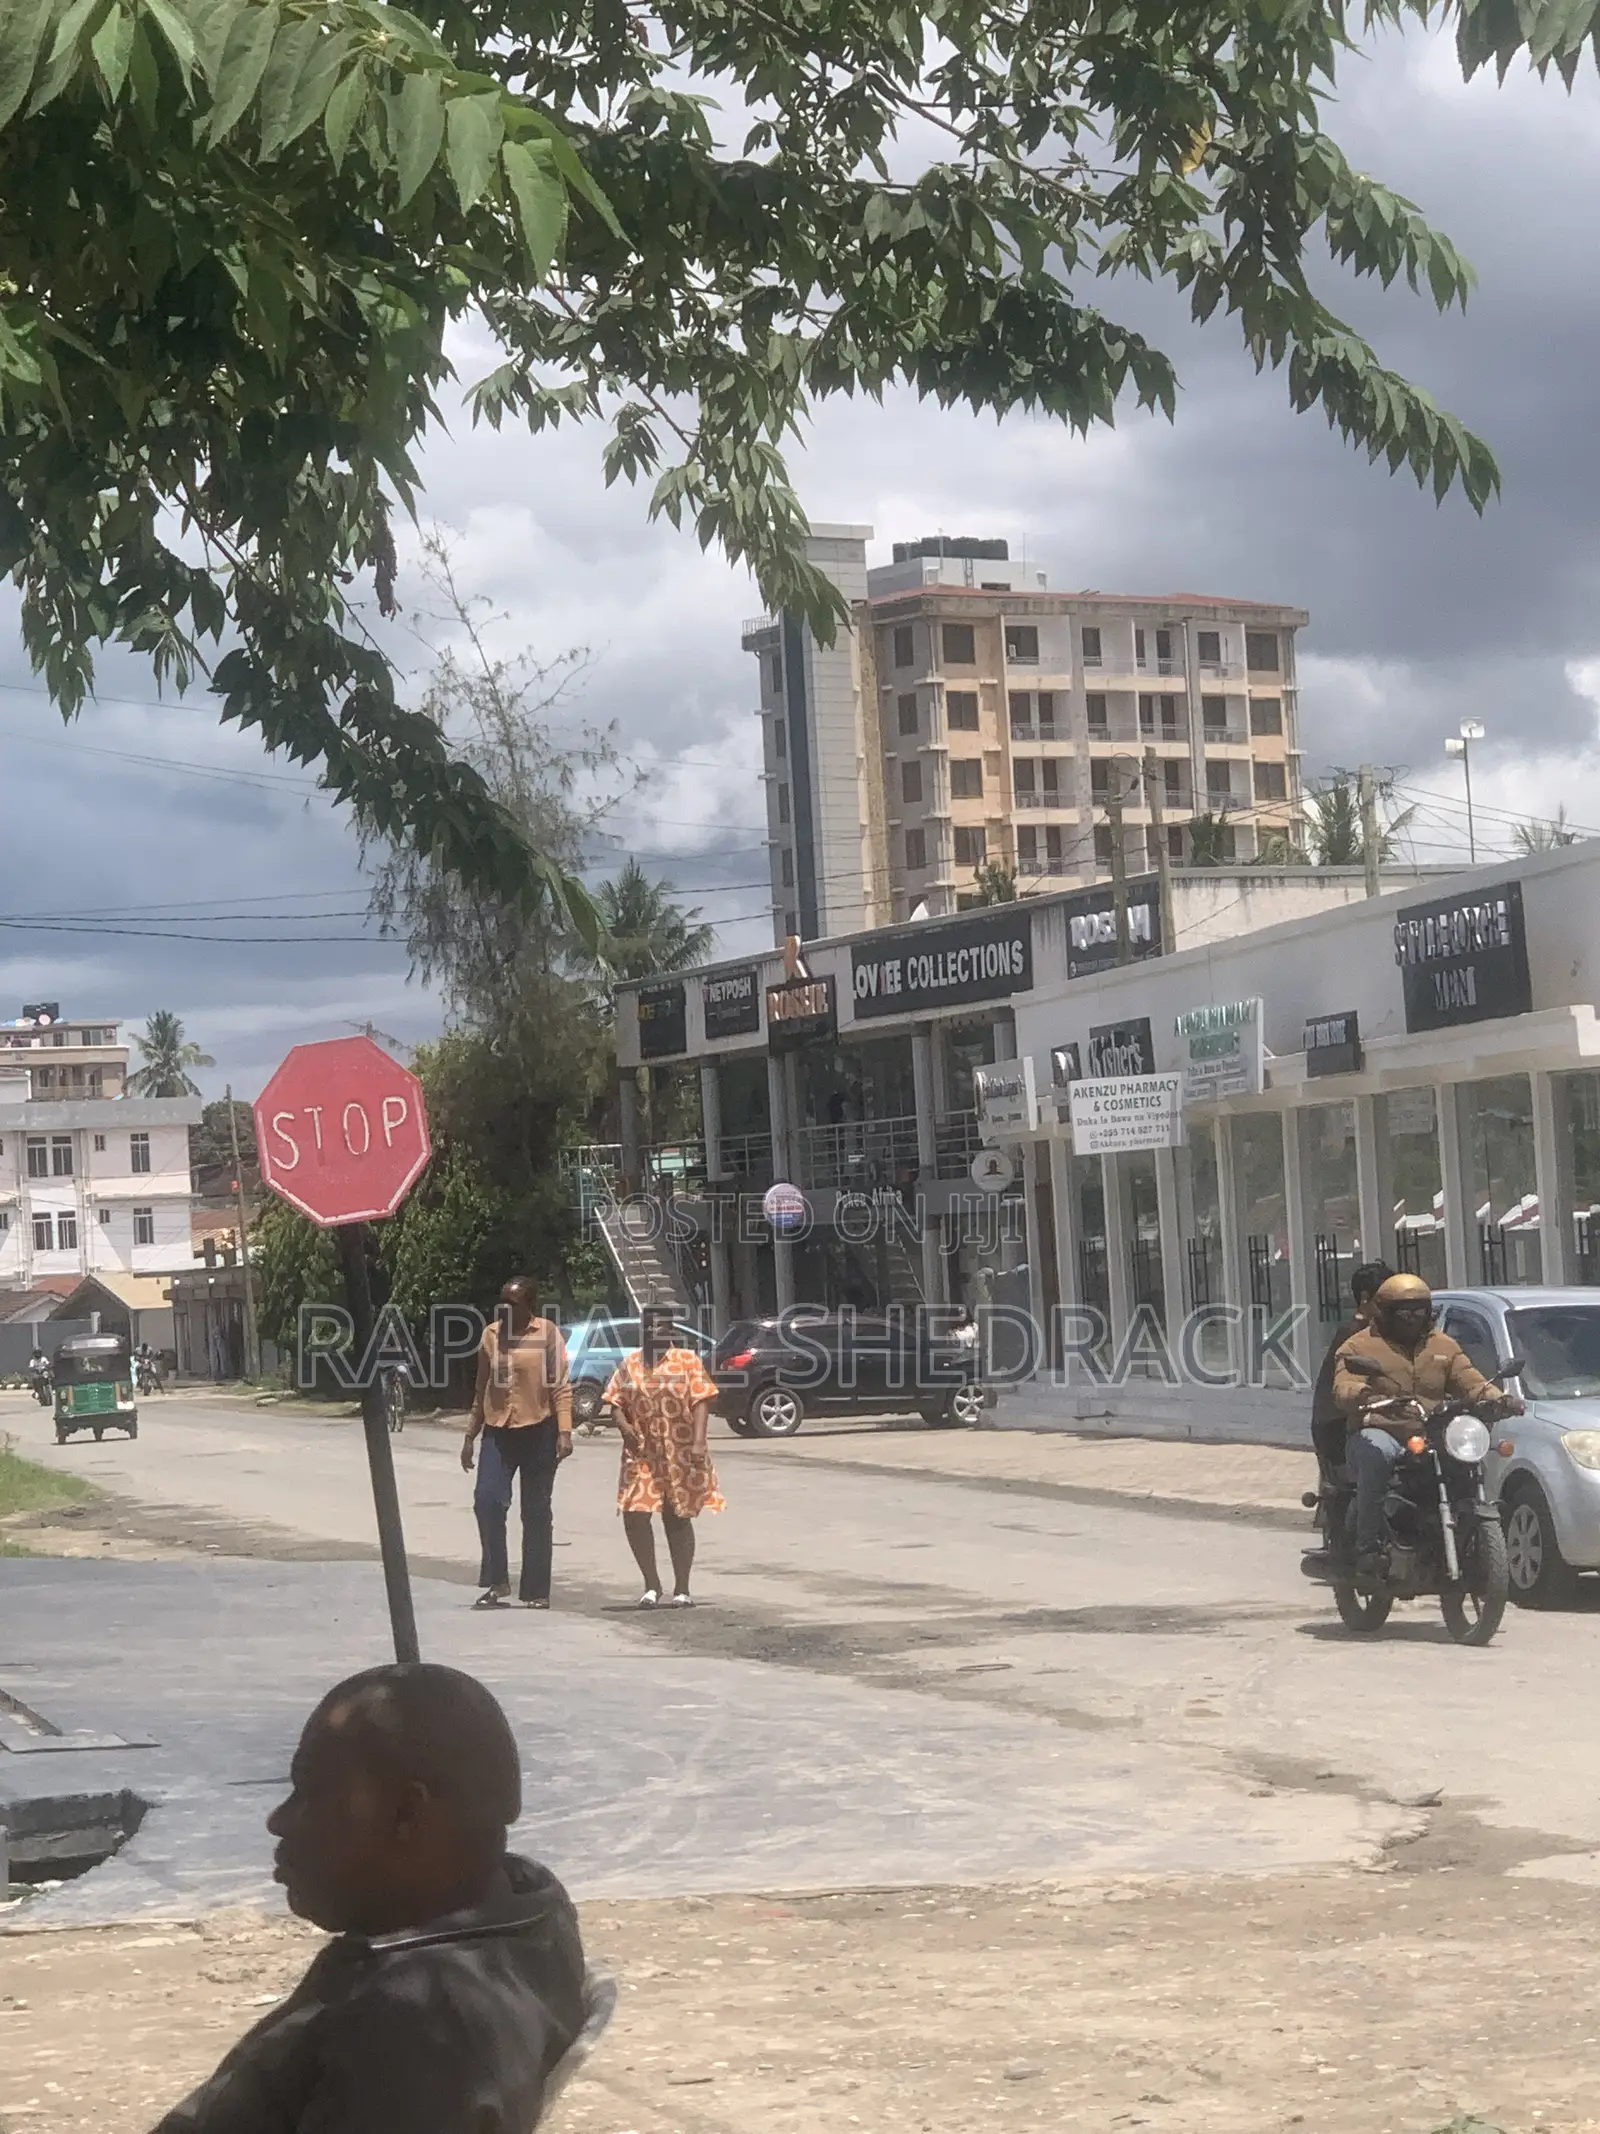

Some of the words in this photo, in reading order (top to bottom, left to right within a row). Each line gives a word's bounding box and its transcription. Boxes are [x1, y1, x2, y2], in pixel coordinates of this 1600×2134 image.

[907, 940, 1024, 990] COLLECTIONS
[1073, 1084, 1117, 1099] AKENZU
[1120, 1079, 1179, 1095] PHARMACY
[1093, 1101, 1100, 1112] &
[1103, 1095, 1162, 1111] COSMETICS
[271, 1096, 407, 1170] STOP
